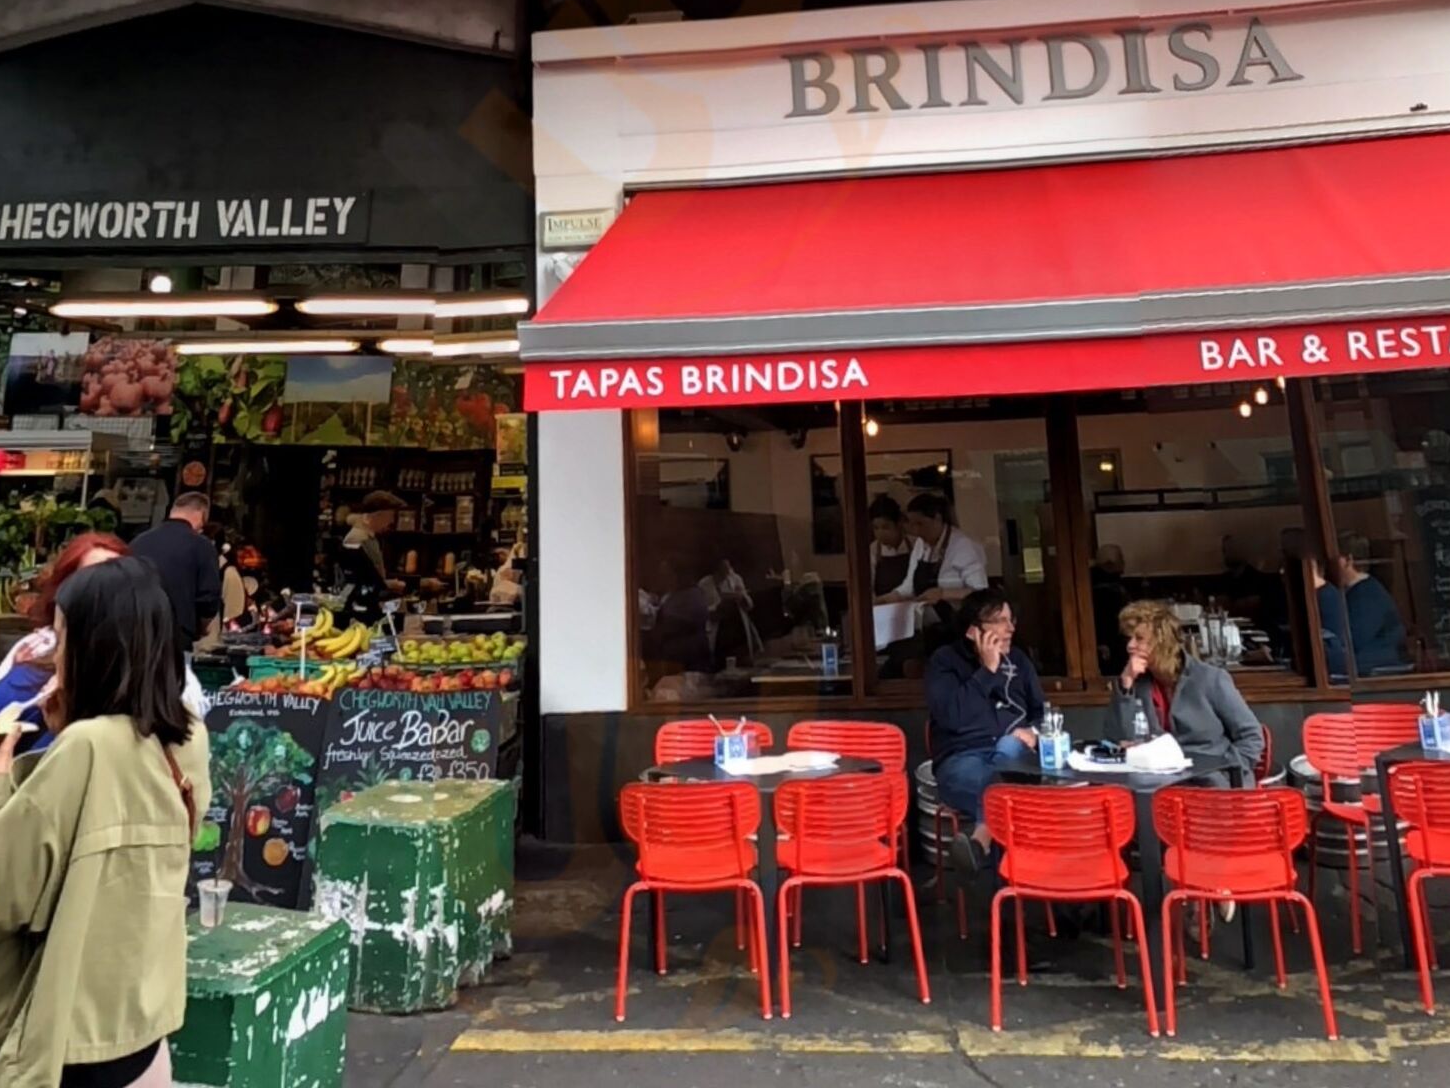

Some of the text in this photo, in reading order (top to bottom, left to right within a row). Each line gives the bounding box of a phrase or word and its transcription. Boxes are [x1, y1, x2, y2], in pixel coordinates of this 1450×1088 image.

[783, 15, 1304, 118] BRINDISA
[217, 196, 357, 237] VALLEY
[1201, 338, 1283, 371] BAR
[1302, 335, 1329, 362] &
[550, 358, 869, 400] TAPAS BRINDISA
[282, 693, 321, 715] VALLEY
[339, 708, 397, 746] Juice
